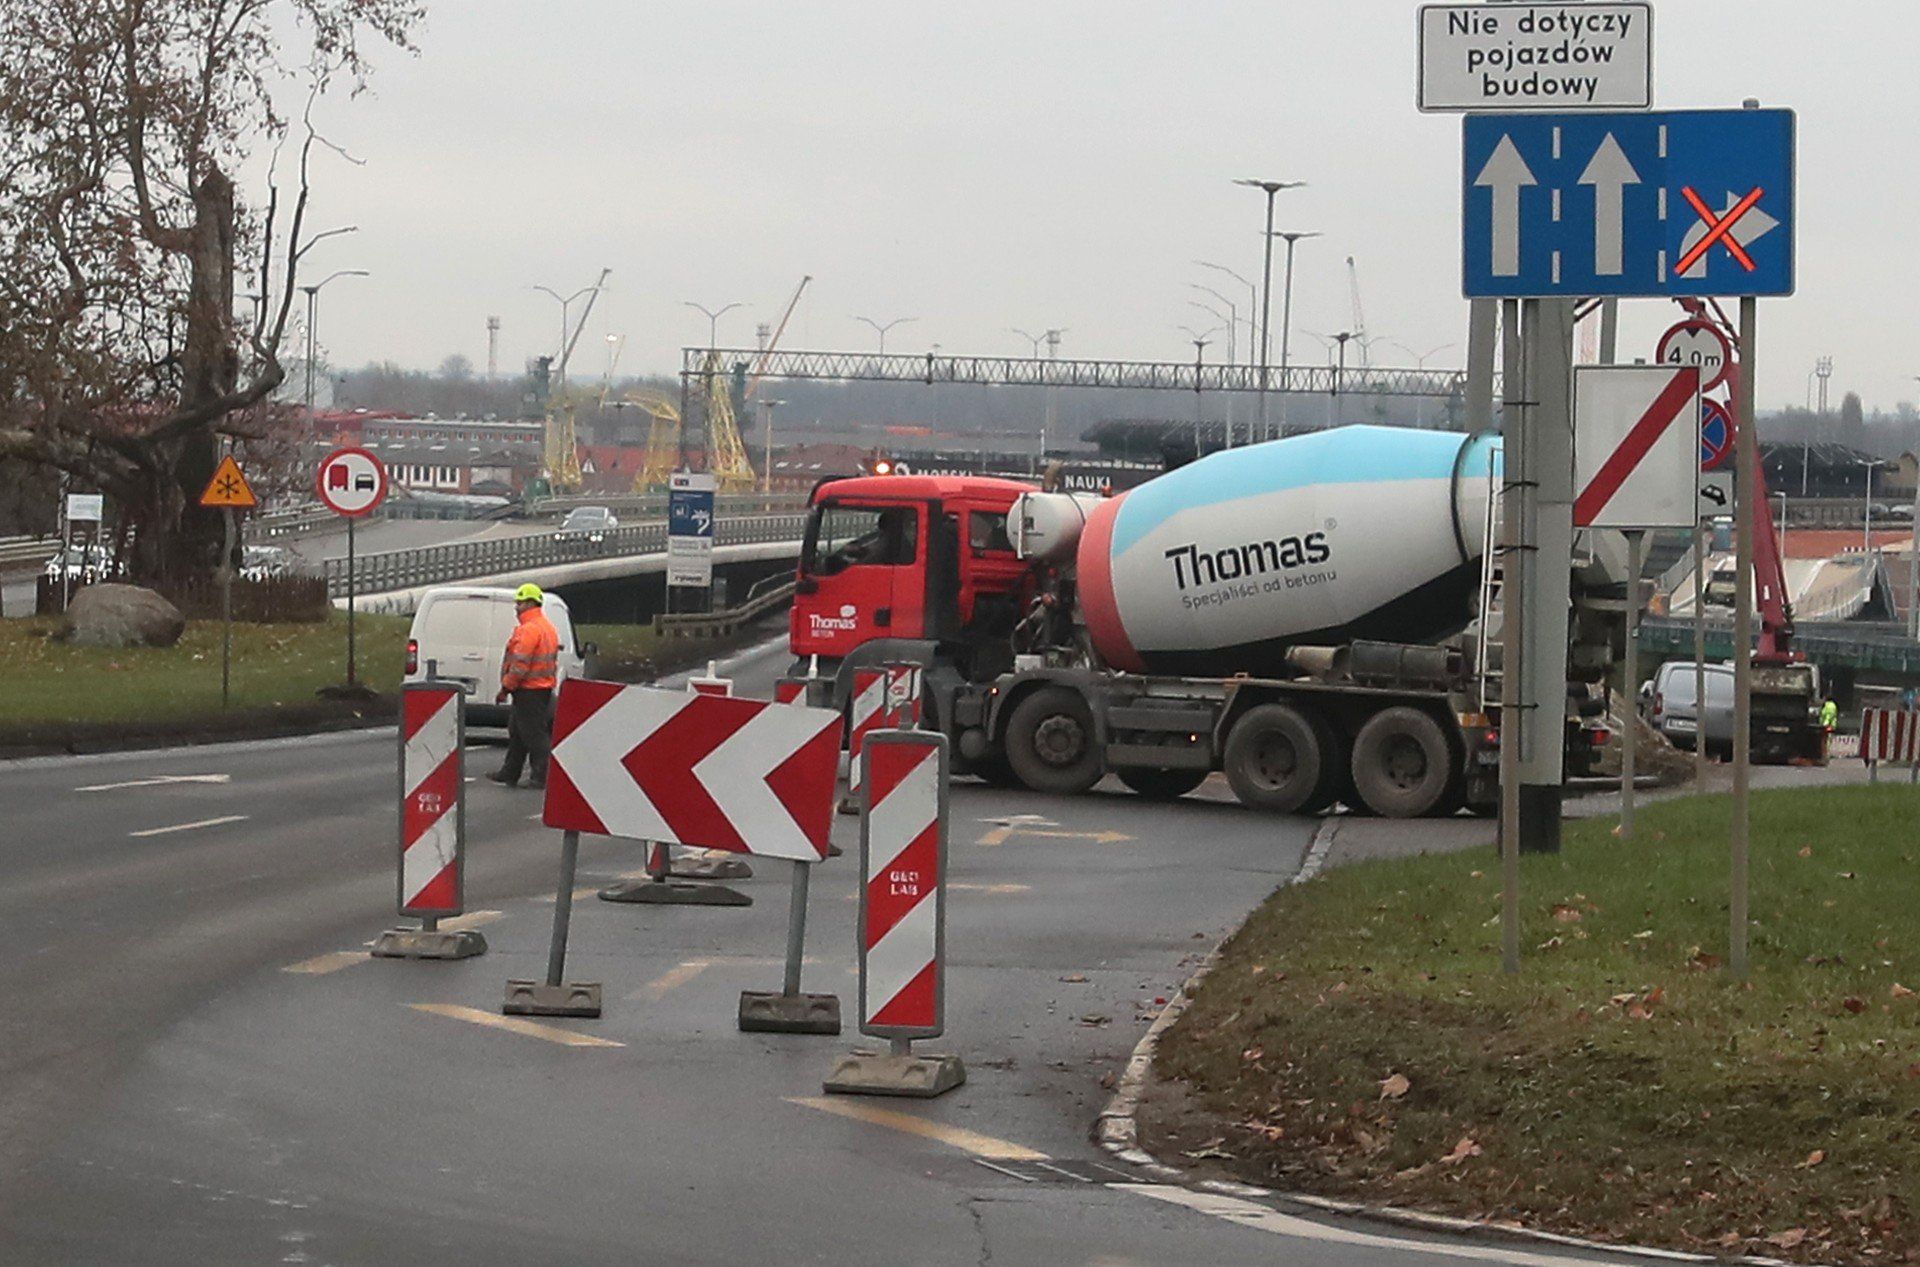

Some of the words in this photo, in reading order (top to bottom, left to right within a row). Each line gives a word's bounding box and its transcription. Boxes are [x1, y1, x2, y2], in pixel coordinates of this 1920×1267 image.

[1449, 10, 1499, 35] Nie
[1518, 9, 1632, 39] dotyczy
[1467, 38, 1614, 73] pojazdów
[1483, 71, 1598, 101] budowy
[1064, 474, 1111, 489] NAUKI
[1165, 531, 1330, 590] Thomas
[1181, 583, 1260, 609] Specjaliści
[1262, 578, 1281, 592] od
[1285, 570, 1337, 589] betonu
[809, 614, 856, 629] Thomas
[890, 884, 918, 895] LAB
